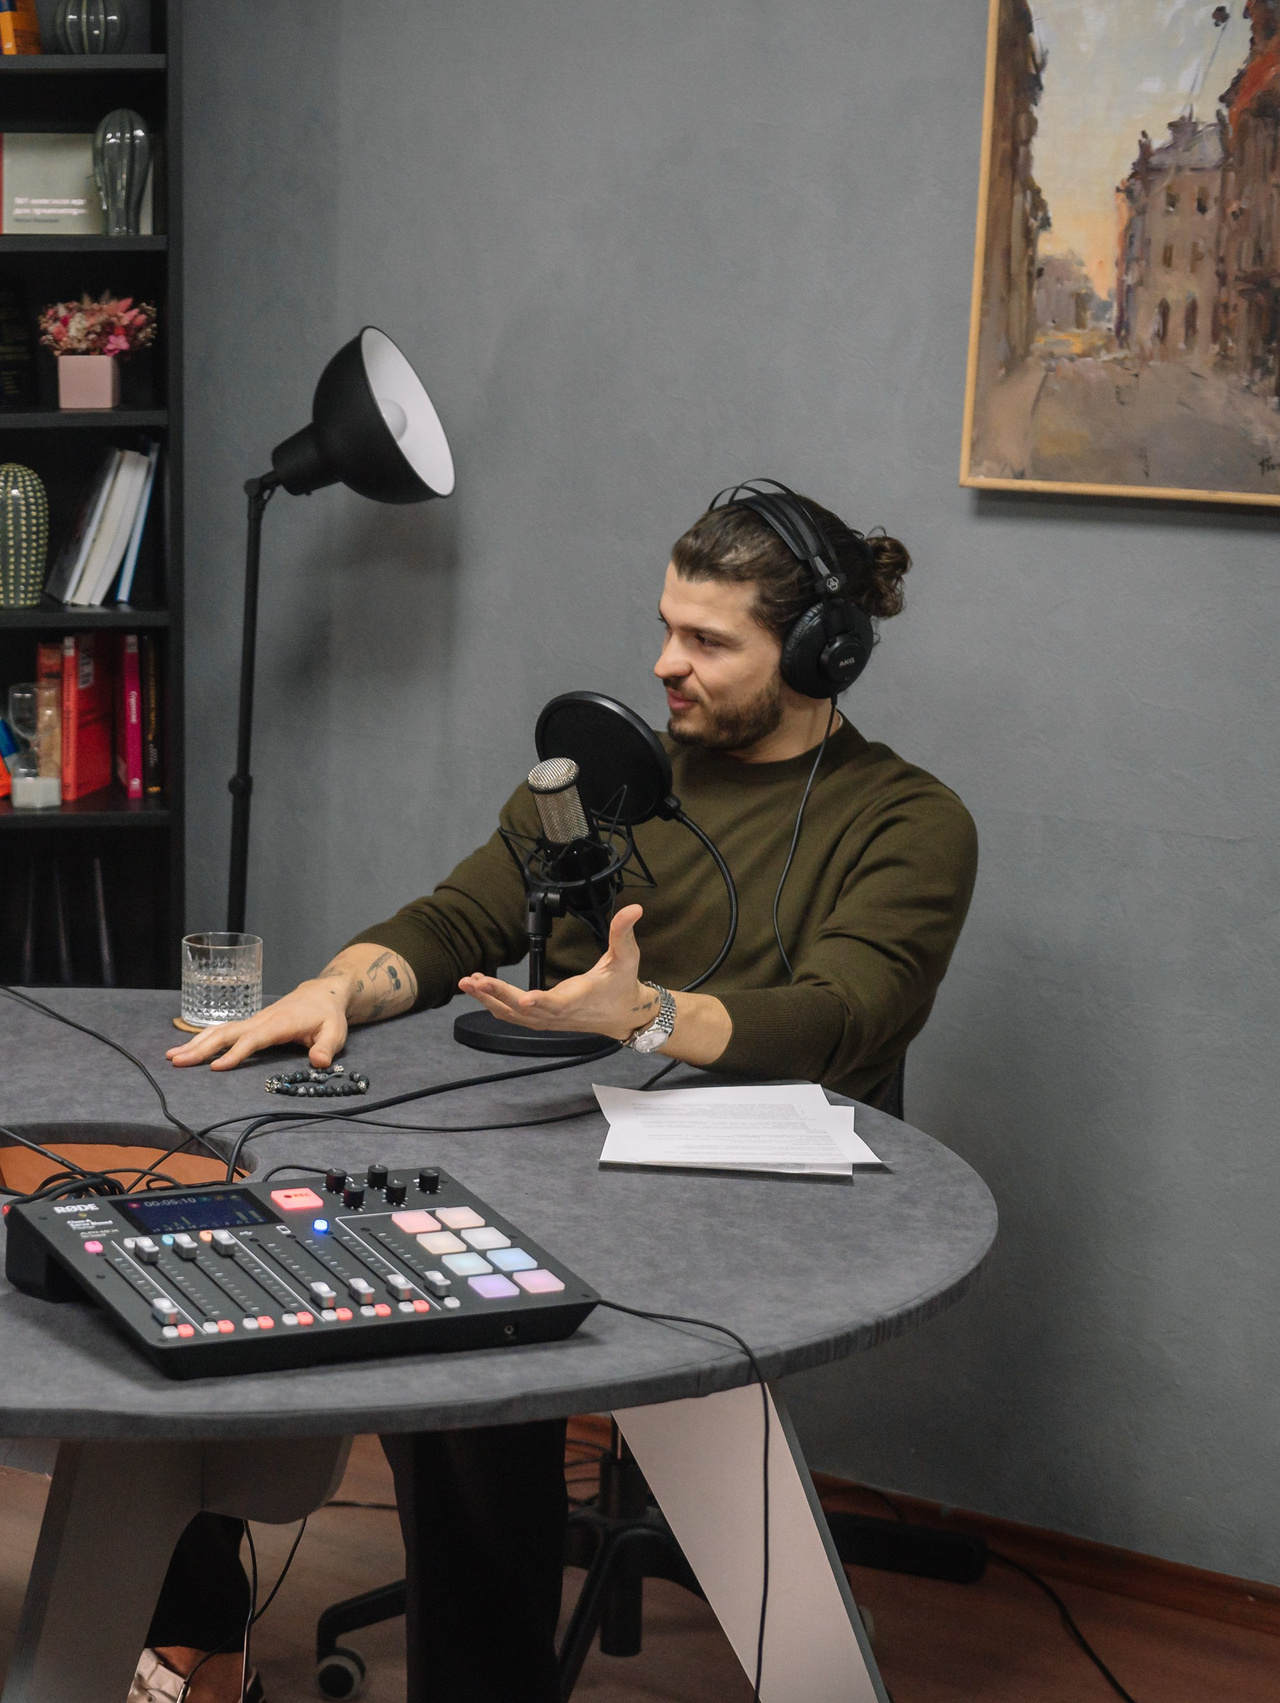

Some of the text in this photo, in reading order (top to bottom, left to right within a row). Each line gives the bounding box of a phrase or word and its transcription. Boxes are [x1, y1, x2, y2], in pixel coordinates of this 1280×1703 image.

[838, 656, 855, 668] AKG
[144, 1197, 197, 1207] 00:05:10
[53, 1203, 100, 1214] RØDE
